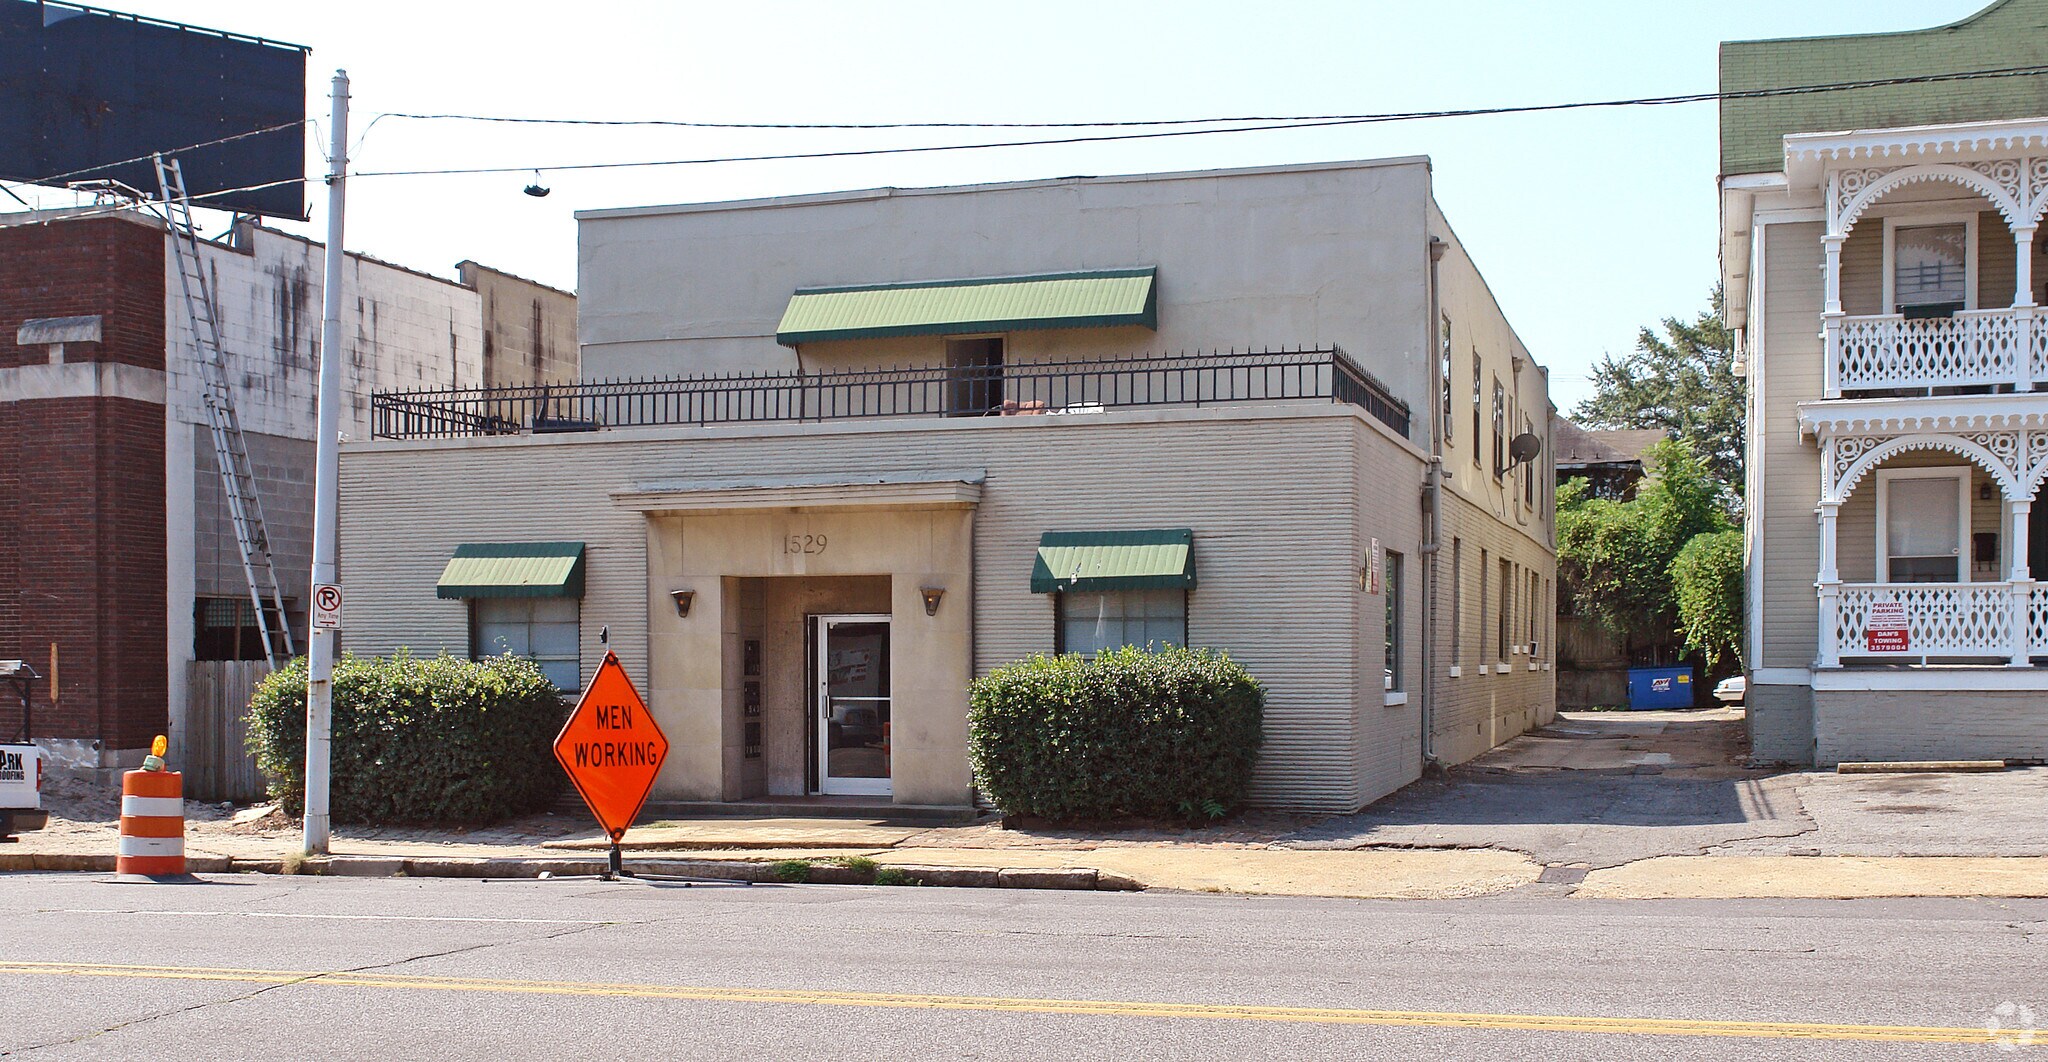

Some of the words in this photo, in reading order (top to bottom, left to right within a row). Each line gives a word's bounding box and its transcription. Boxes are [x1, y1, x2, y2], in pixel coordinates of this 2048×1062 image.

[783, 534, 828, 555] 1529
[596, 705, 633, 730] MEN
[574, 741, 657, 768] WORKING
